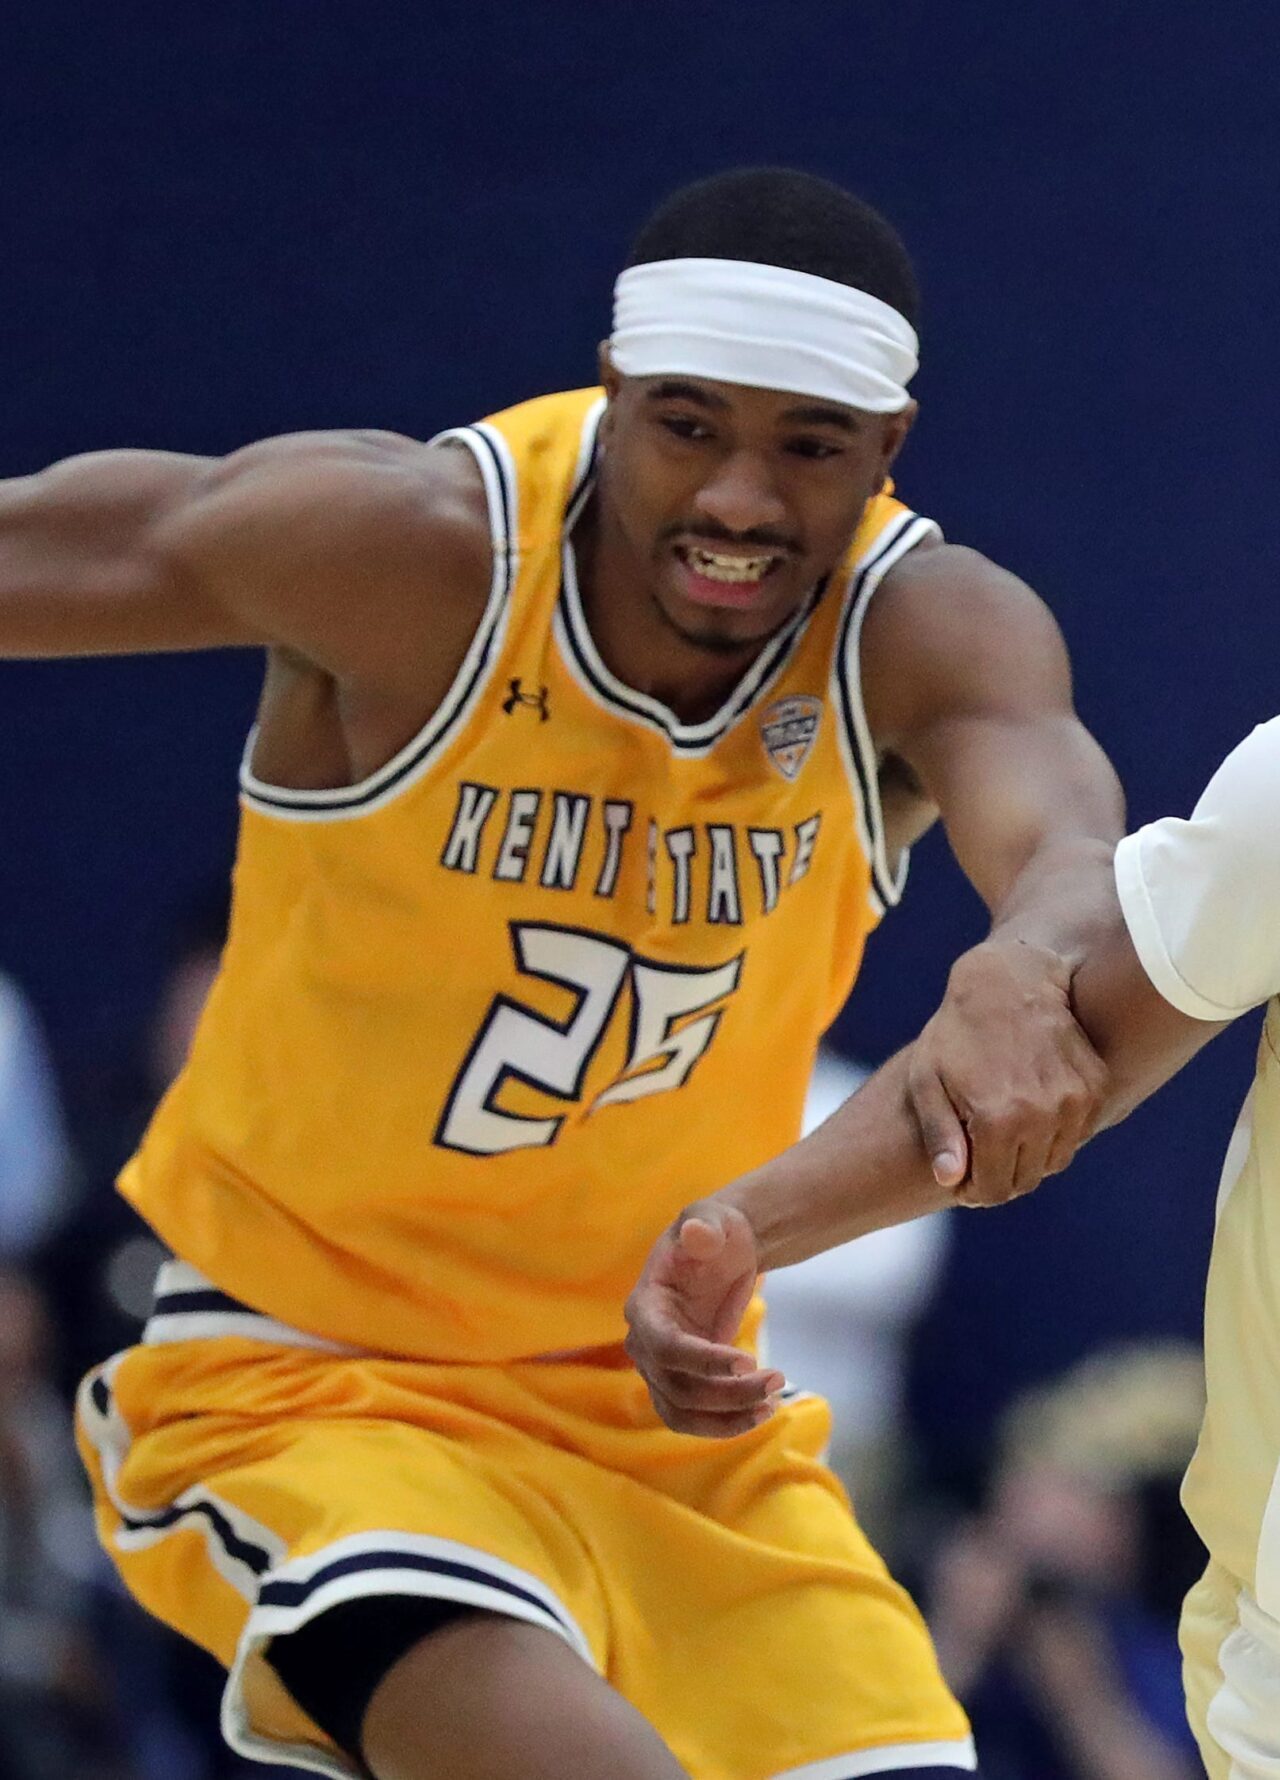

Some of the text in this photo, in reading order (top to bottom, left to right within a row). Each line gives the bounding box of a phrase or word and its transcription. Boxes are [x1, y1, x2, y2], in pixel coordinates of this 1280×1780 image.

[441, 782, 822, 924] KENT TATE
[433, 920, 747, 1156] 25
